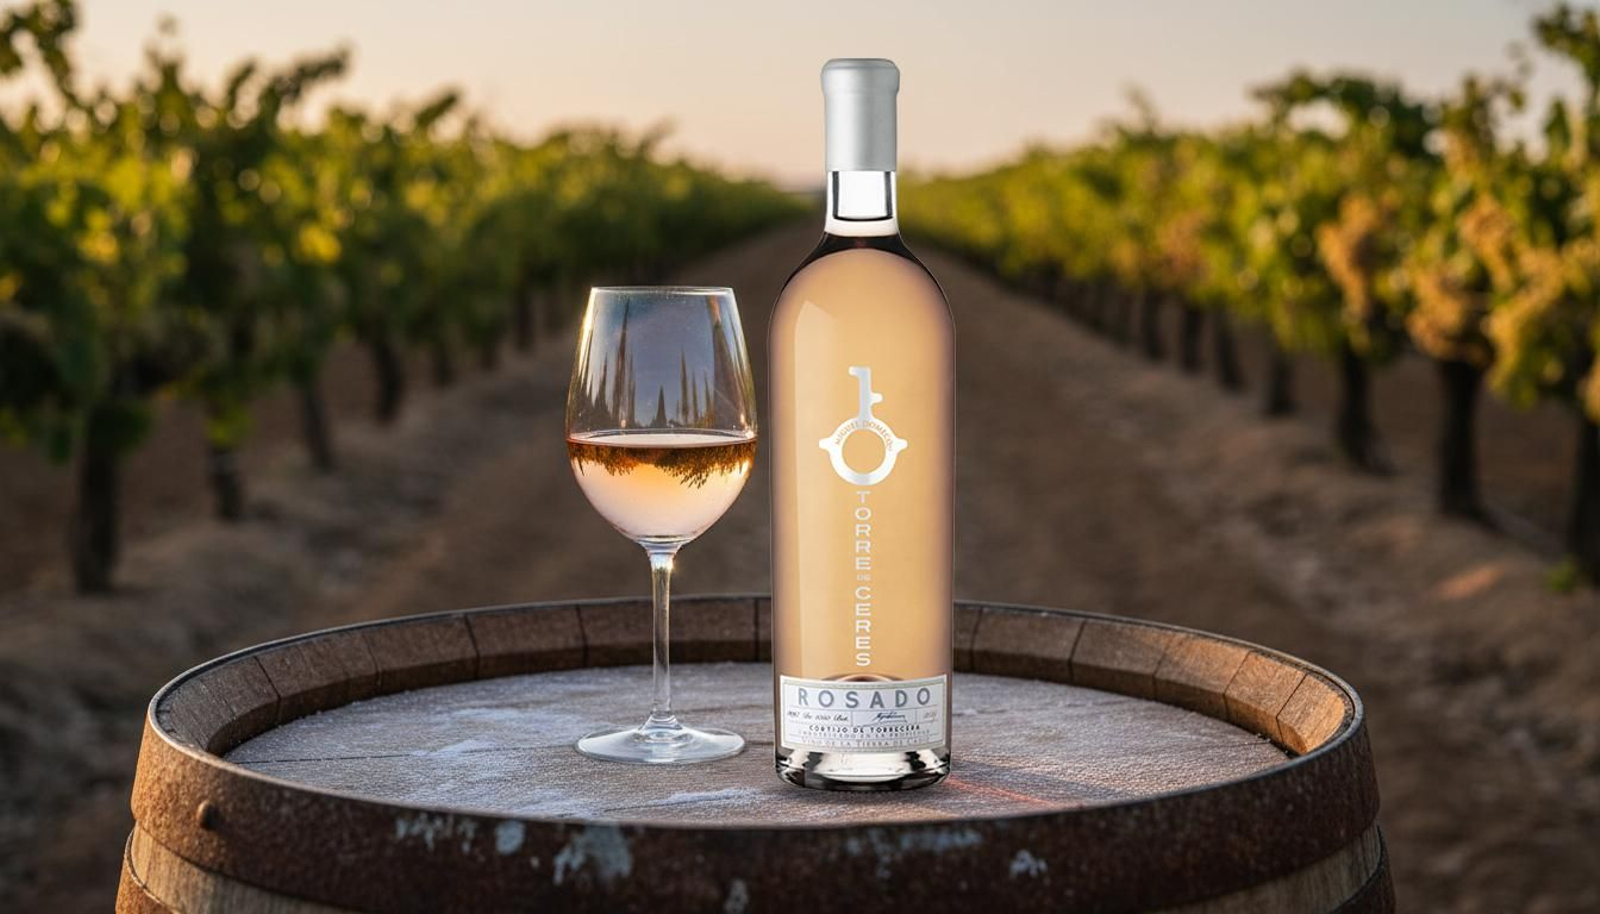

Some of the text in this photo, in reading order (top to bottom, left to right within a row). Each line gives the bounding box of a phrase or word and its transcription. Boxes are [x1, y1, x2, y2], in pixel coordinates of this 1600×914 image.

[855, 490, 871, 570] TORRE
[855, 586, 871, 666] CERES
[798, 687, 930, 709] ROSADO
[809, 725, 848, 733] CORTIJO
